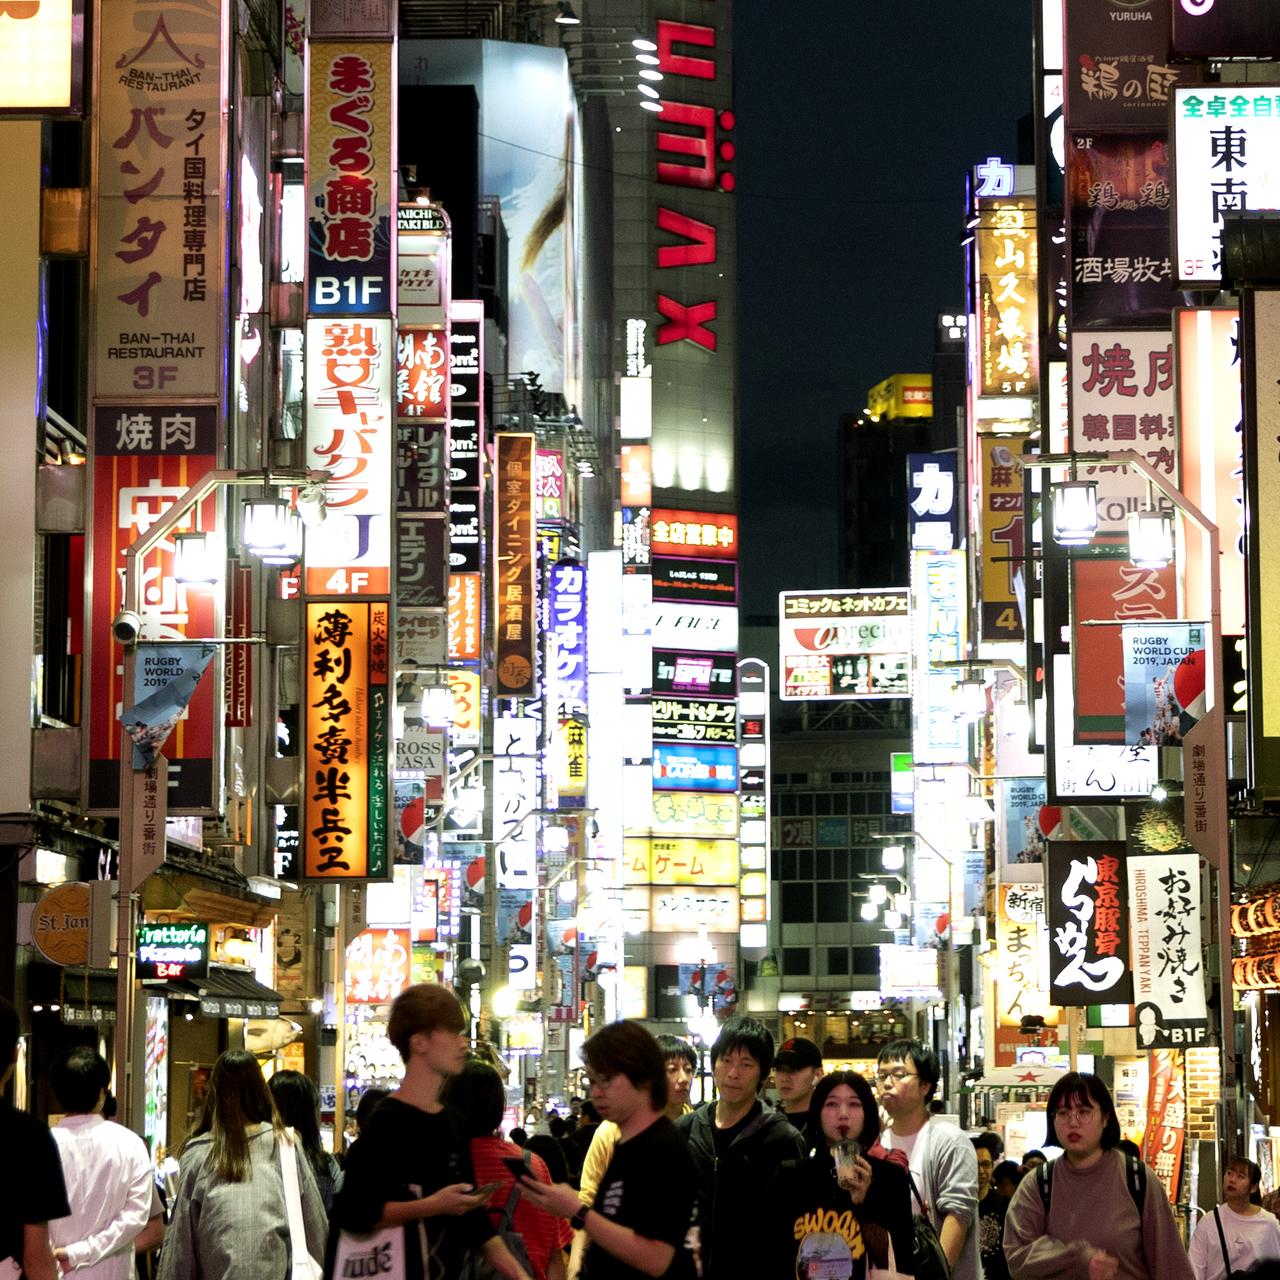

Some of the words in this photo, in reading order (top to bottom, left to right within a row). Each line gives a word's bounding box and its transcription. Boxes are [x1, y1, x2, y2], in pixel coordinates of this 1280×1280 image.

[1109, 11, 1153, 22] YURUHA
[119, 71, 202, 92] RESTAURANT
[128, 67, 192, 81] BAN-THAI
[321, 54, 379, 263] まぐろ商店
[974, 156, 1014, 197] カ
[113, 106, 173, 318] バンタイ
[182, 107, 208, 303] タイ国料理専門店
[314, 276, 384, 306] B1F
[119, 332, 196, 346] BAN-THAI
[107, 346, 206, 360] RESTAURANT
[132, 366, 179, 391] 3F
[115, 413, 197, 451] 焼肉
[399, 521, 426, 583] エデン
[325, 575, 370, 594] 4F
[996, 609, 1019, 632] 4
[370, 609, 387, 676] 炭火串焼
[1132, 636, 1169, 647] RUGBY
[1132, 646, 1171, 657] WORLD
[1172, 646, 1196, 657] CUP
[143, 656, 182, 667] RUGBY
[143, 667, 185, 677] WORLD
[1160, 657, 1196, 668] JAPAN
[143, 677, 168, 687] 2019
[1191, 743, 1208, 834] 劇場通り一番街
[1094, 854, 1121, 957] 東京豚骨
[1135, 868, 1147, 924] HIROSHIMA
[1155, 866, 1200, 1005] お好み焼き
[1170, 1026, 1207, 1044] B1F
[975, 1085, 1052, 1096] Heinek
